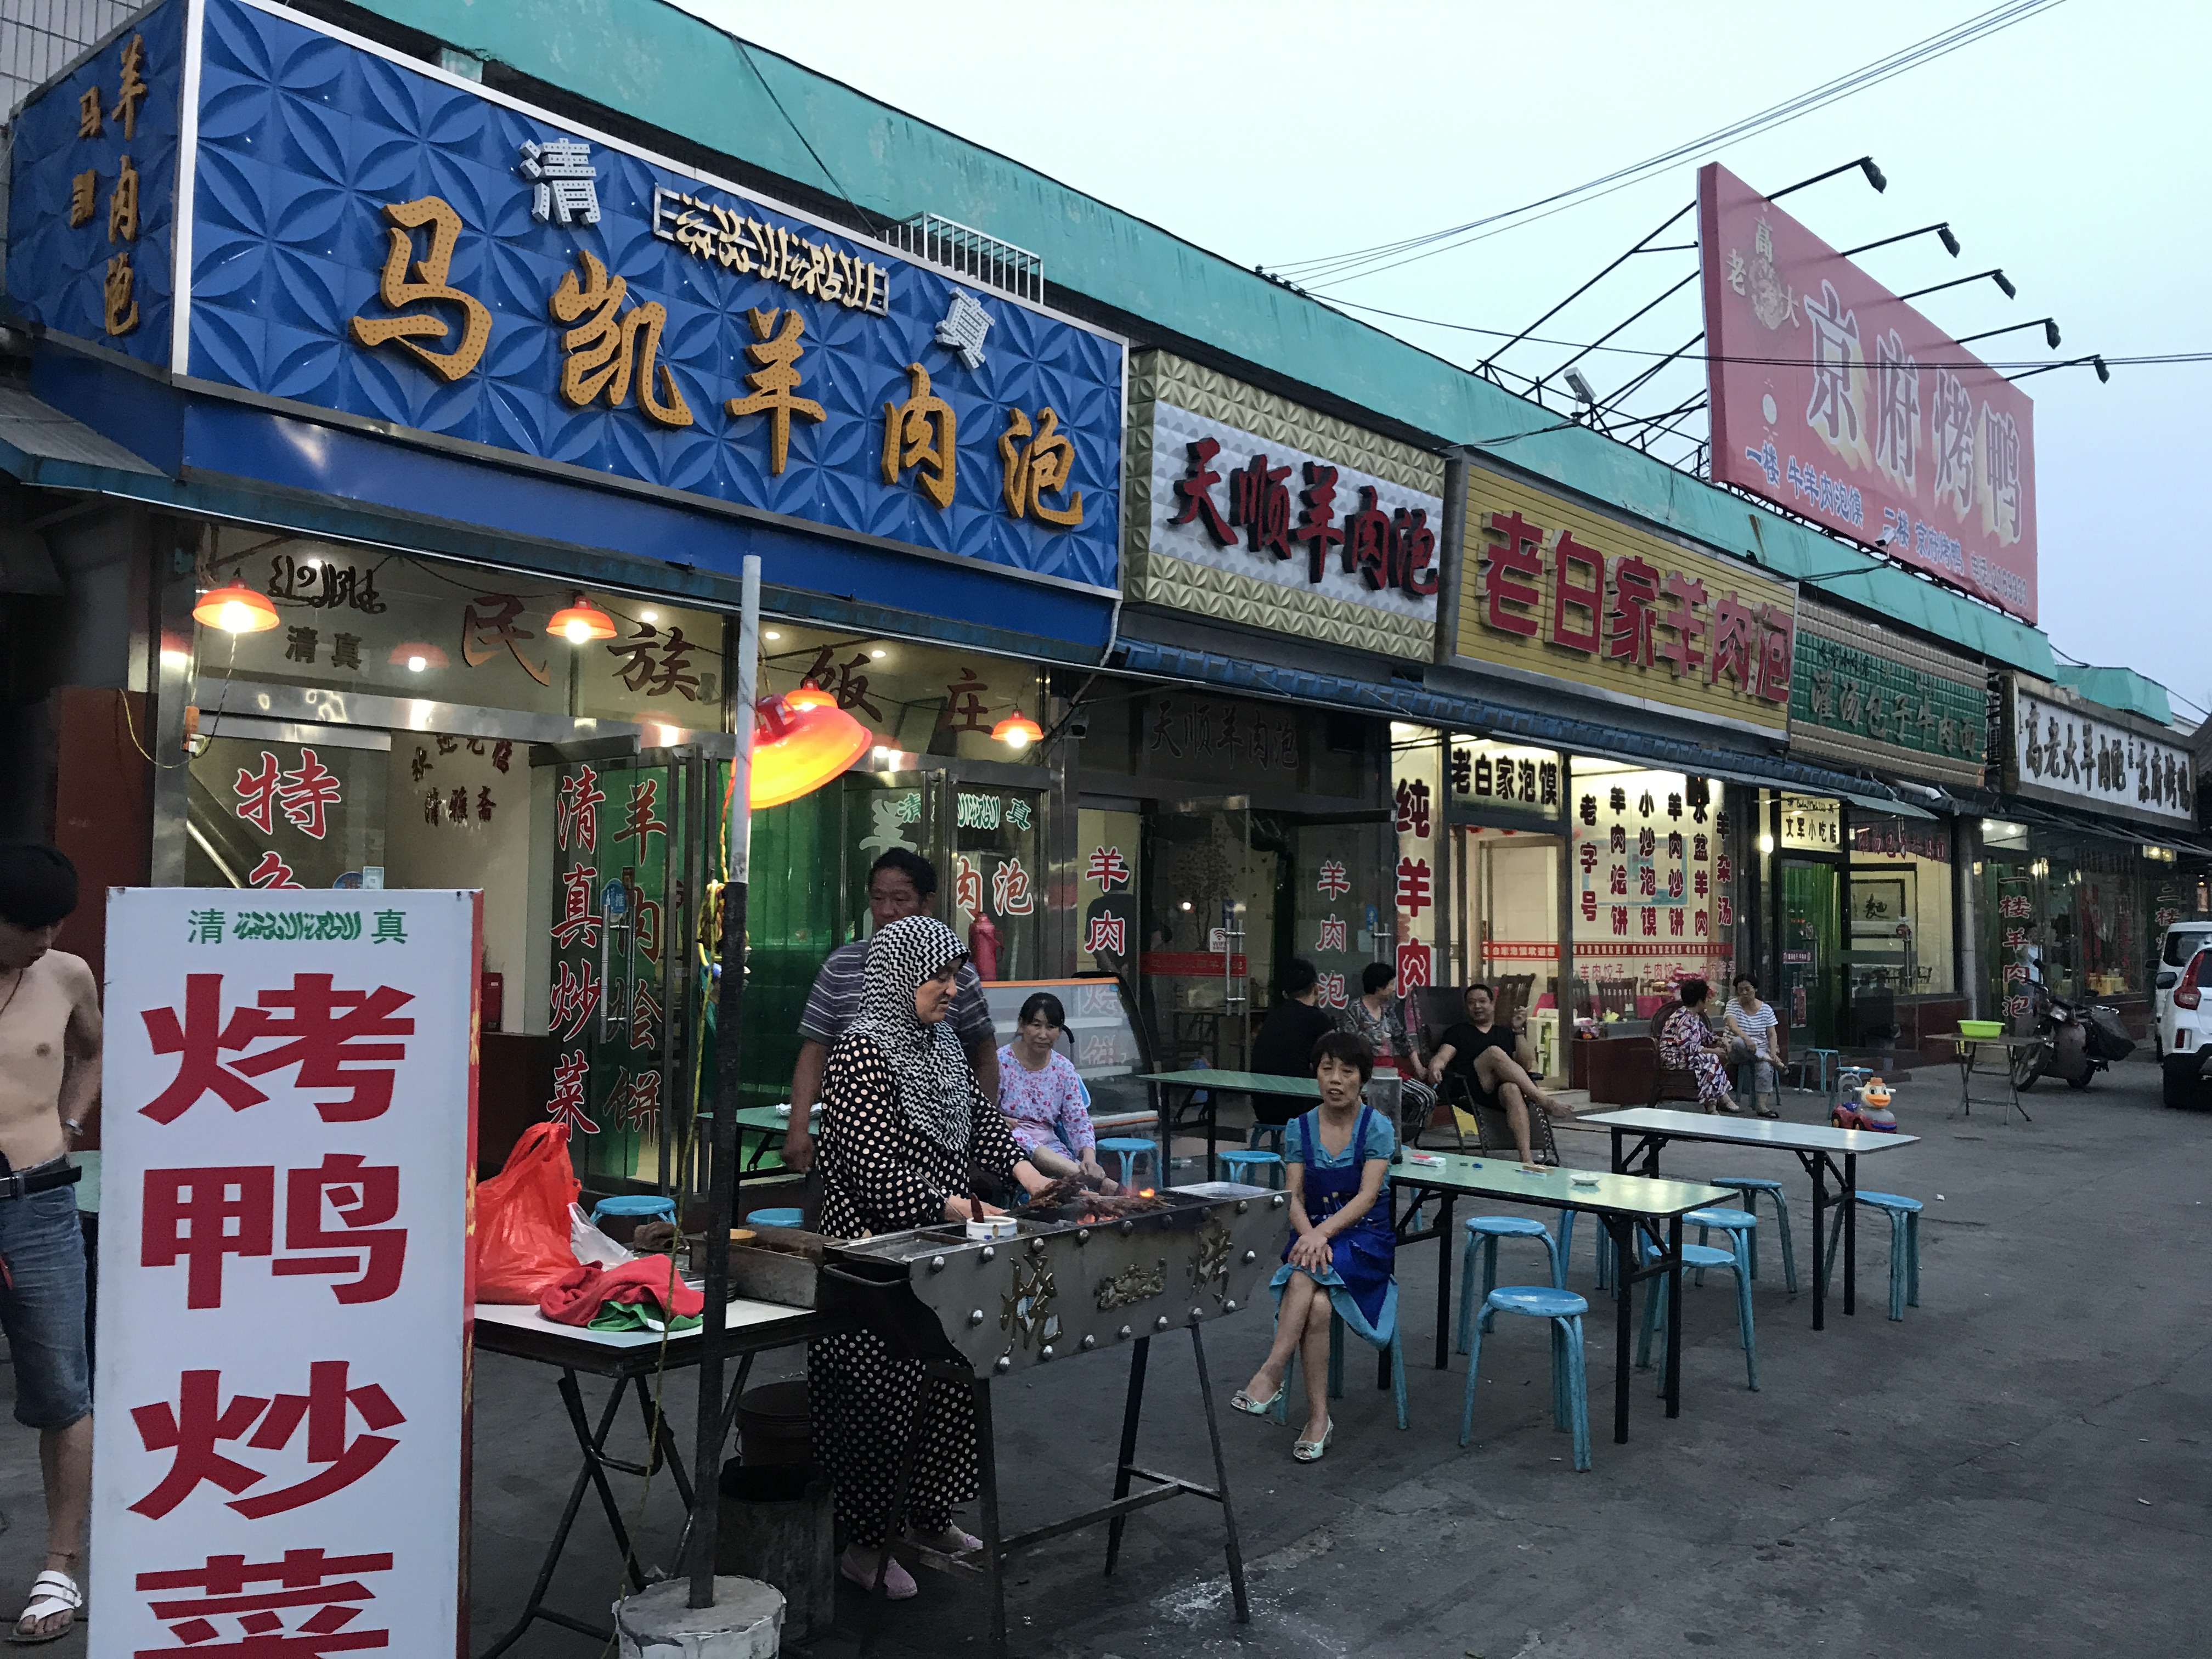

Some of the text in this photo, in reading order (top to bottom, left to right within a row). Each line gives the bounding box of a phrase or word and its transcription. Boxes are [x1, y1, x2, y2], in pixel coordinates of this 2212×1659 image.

[104, 34, 148, 336] 羊肉泡
[520, 138, 995, 369] 清 真
[1726, 215, 1801, 329] 高 老 大
[348, 195, 1084, 526] 马凯羊肉泡
[1804, 279, 2022, 544] 京府烤鸭
[1166, 437, 1438, 596] 天顺羊肉泡
[1745, 438, 1781, 490] 一楼
[1787, 456, 1864, 530] 牛羊肉泡馍
[1915, 520, 1965, 577] 京府烤鸭
[285, 625, 363, 670] 清真
[1476, 510, 1794, 705] 老白家羊肉泡
[1151, 699, 1300, 770] 天顺羊肉泡
[1451, 747, 1558, 805] 老白家泡馍
[1006, 798, 1031, 831] 真
[1579, 793, 1598, 922] 老字号
[1610, 784, 1628, 936] 羊肉烩饼
[1639, 789, 1657, 937] 小炒泡馍
[1667, 792, 1684, 936] 羊肉炒饼
[1716, 811, 1733, 926] 羊杂汤
[187, 908, 409, 945] 清 真
[547, 764, 606, 1141] 清真炒菜
[1316, 859, 1351, 1009] 羊肉泡
[1395, 777, 1432, 1000] 纯羊肉
[1999, 876, 2032, 1018] 一楼羊肉泡
[1580, 963, 1624, 983] 羊肉饺子
[126, 973, 417, 1659] 烤鸭炒菜
